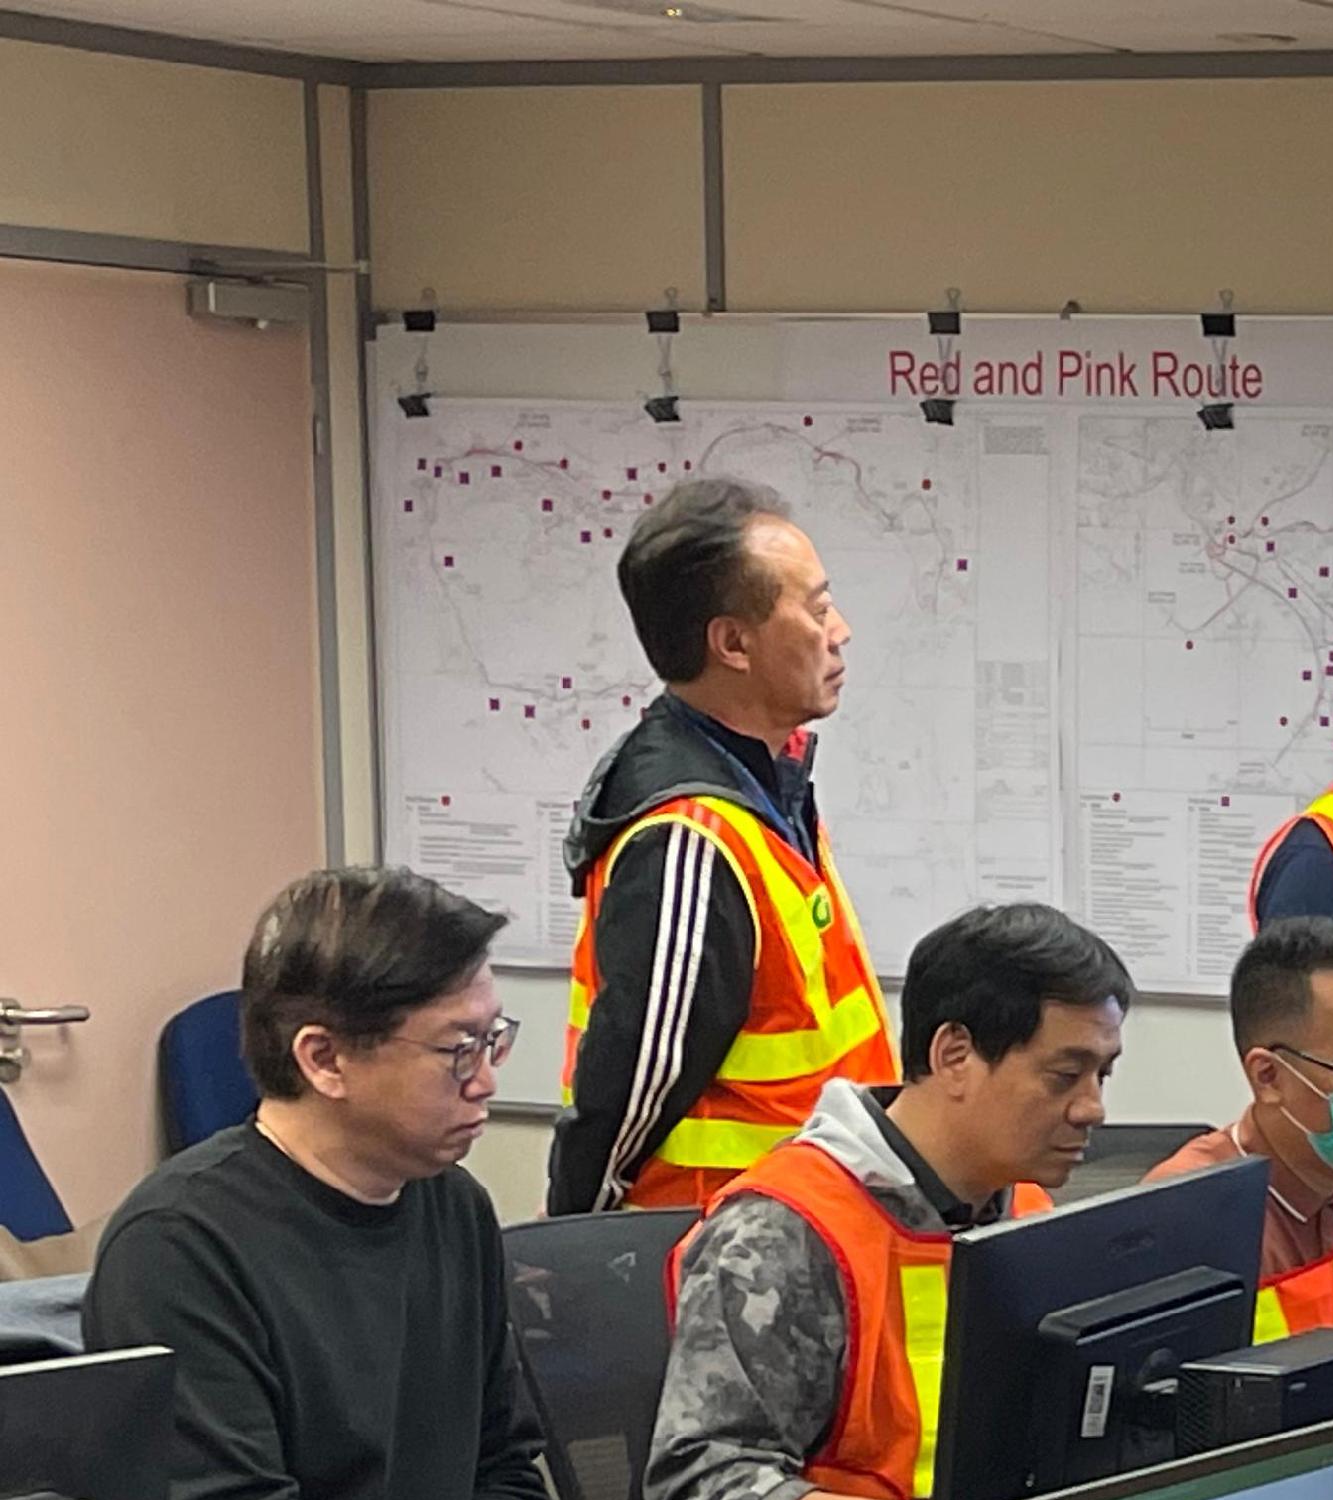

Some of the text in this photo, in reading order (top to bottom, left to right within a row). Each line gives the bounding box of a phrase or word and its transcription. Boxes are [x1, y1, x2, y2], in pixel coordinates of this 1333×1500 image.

[888, 350, 1263, 399] Red and Pink Route
